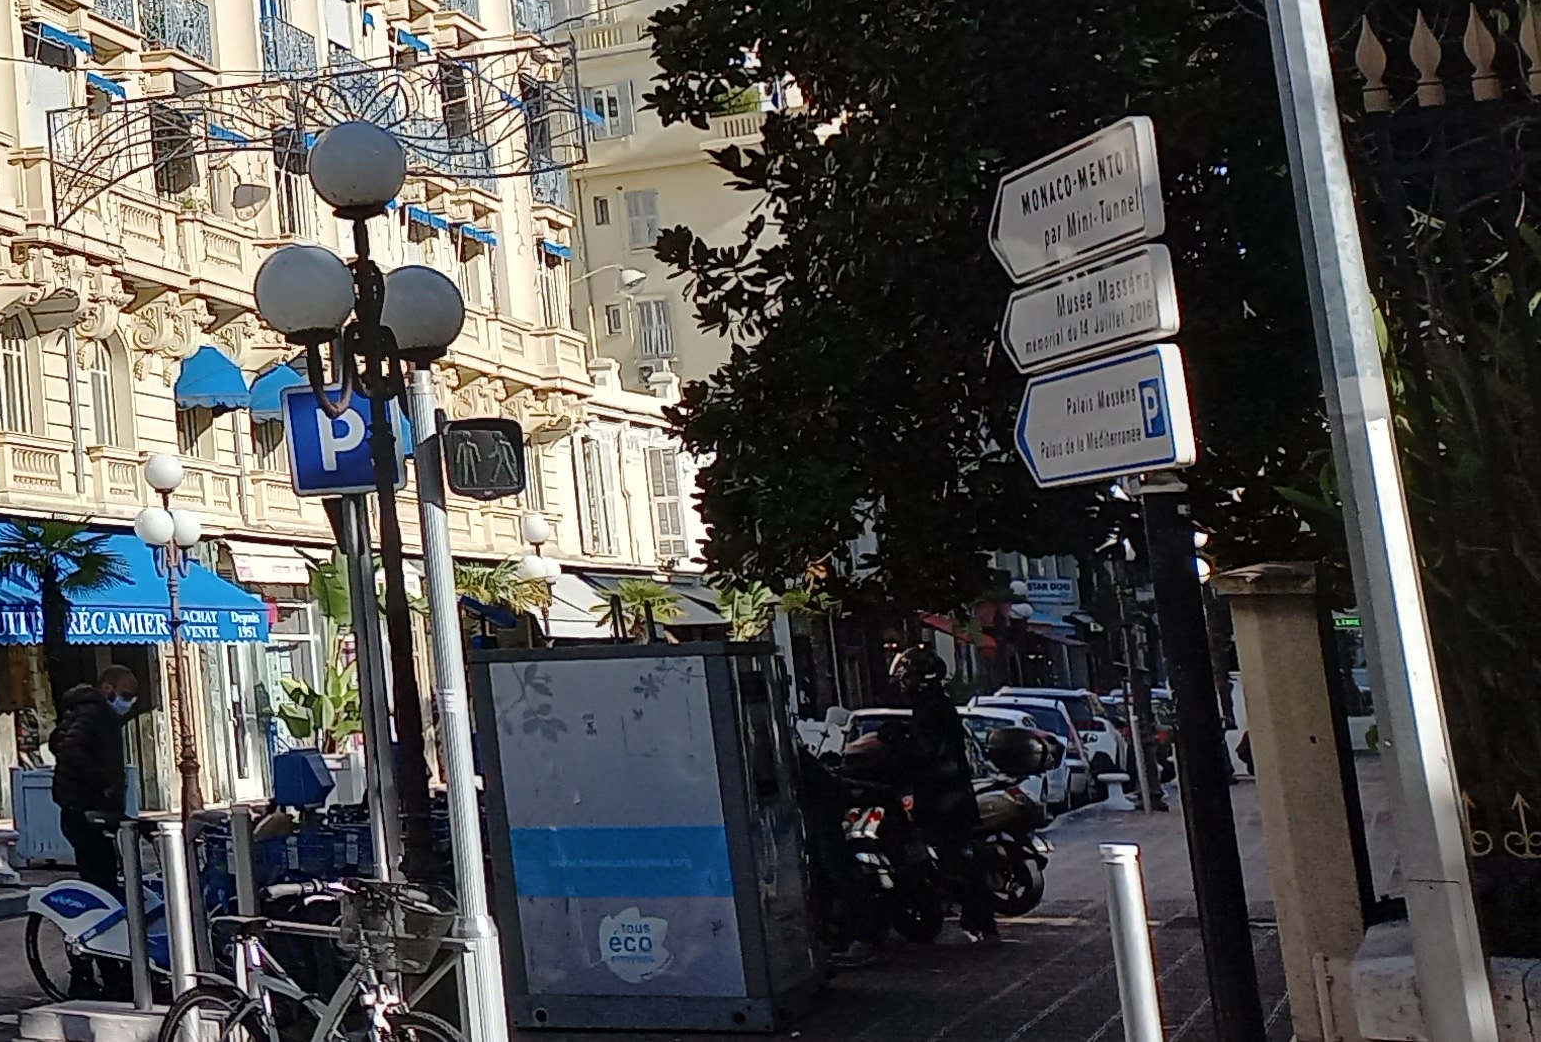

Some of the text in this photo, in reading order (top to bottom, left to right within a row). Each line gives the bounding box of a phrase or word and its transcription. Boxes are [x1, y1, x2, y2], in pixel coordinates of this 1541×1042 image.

[1021, 147, 1134, 216] MONACO-MENTON
[1044, 186, 1139, 254] par Mini-Tunnel
[1056, 269, 1150, 317] Musée Masséna
[1026, 325, 1064, 354] mémorial
[1068, 323, 1078, 342] du
[1079, 318, 1089, 336] 14
[1130, 299, 1153, 323] 2016
[1067, 394, 1093, 416] Palais
[316, 408, 365, 471] P
[1040, 424, 1142, 458] Palais de la Méditerranée
[65, 606, 170, 635] RÉCAMIER
[182, 610, 217, 623] ACHAT
[230, 610, 260, 625] Depuis
[183, 626, 220, 638] VENTE
[609, 931, 652, 952] éco
[621, 923, 650, 934] tous
